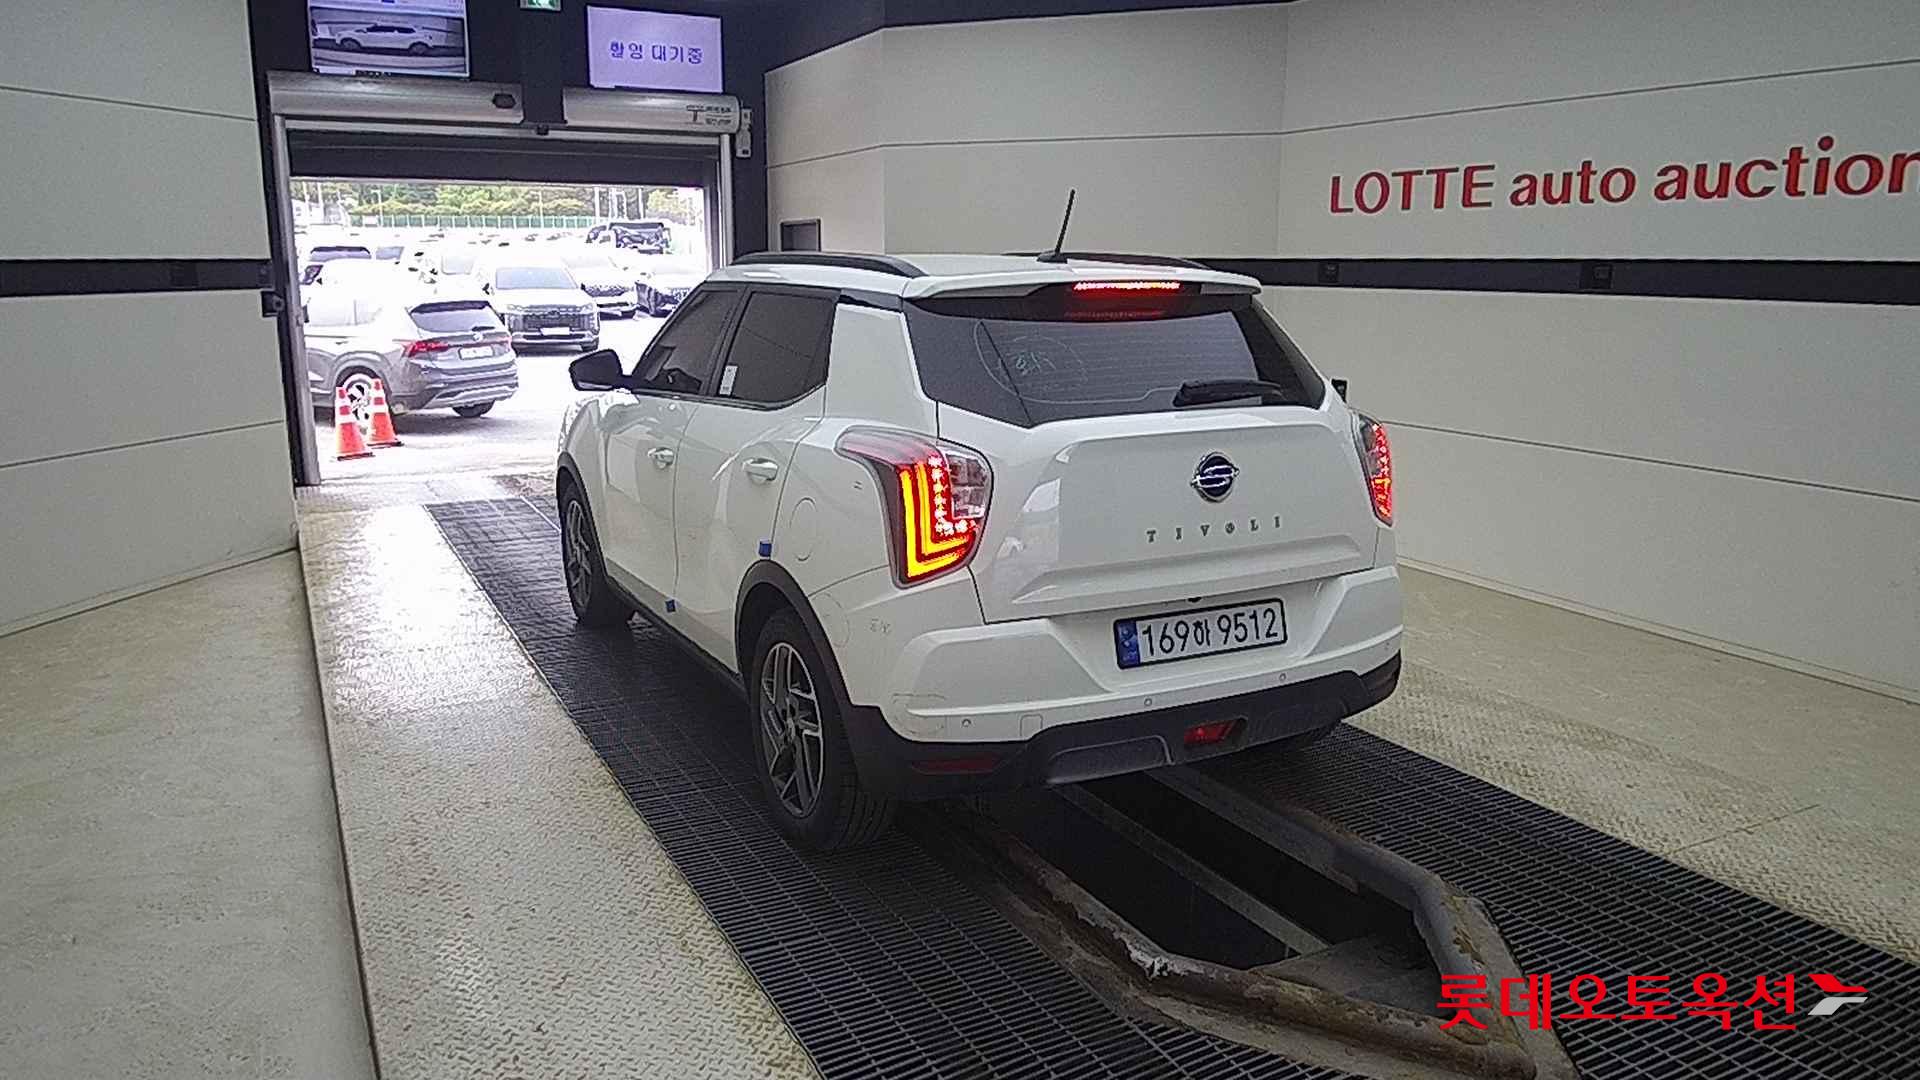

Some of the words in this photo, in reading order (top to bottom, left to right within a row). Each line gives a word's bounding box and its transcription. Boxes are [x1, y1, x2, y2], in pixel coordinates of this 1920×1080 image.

[651, 44, 703, 65] 대기중
[1330, 164, 1496, 214] LOTTE
[1510, 160, 1636, 206] auto
[1146, 515, 1281, 543] TIVOLI
